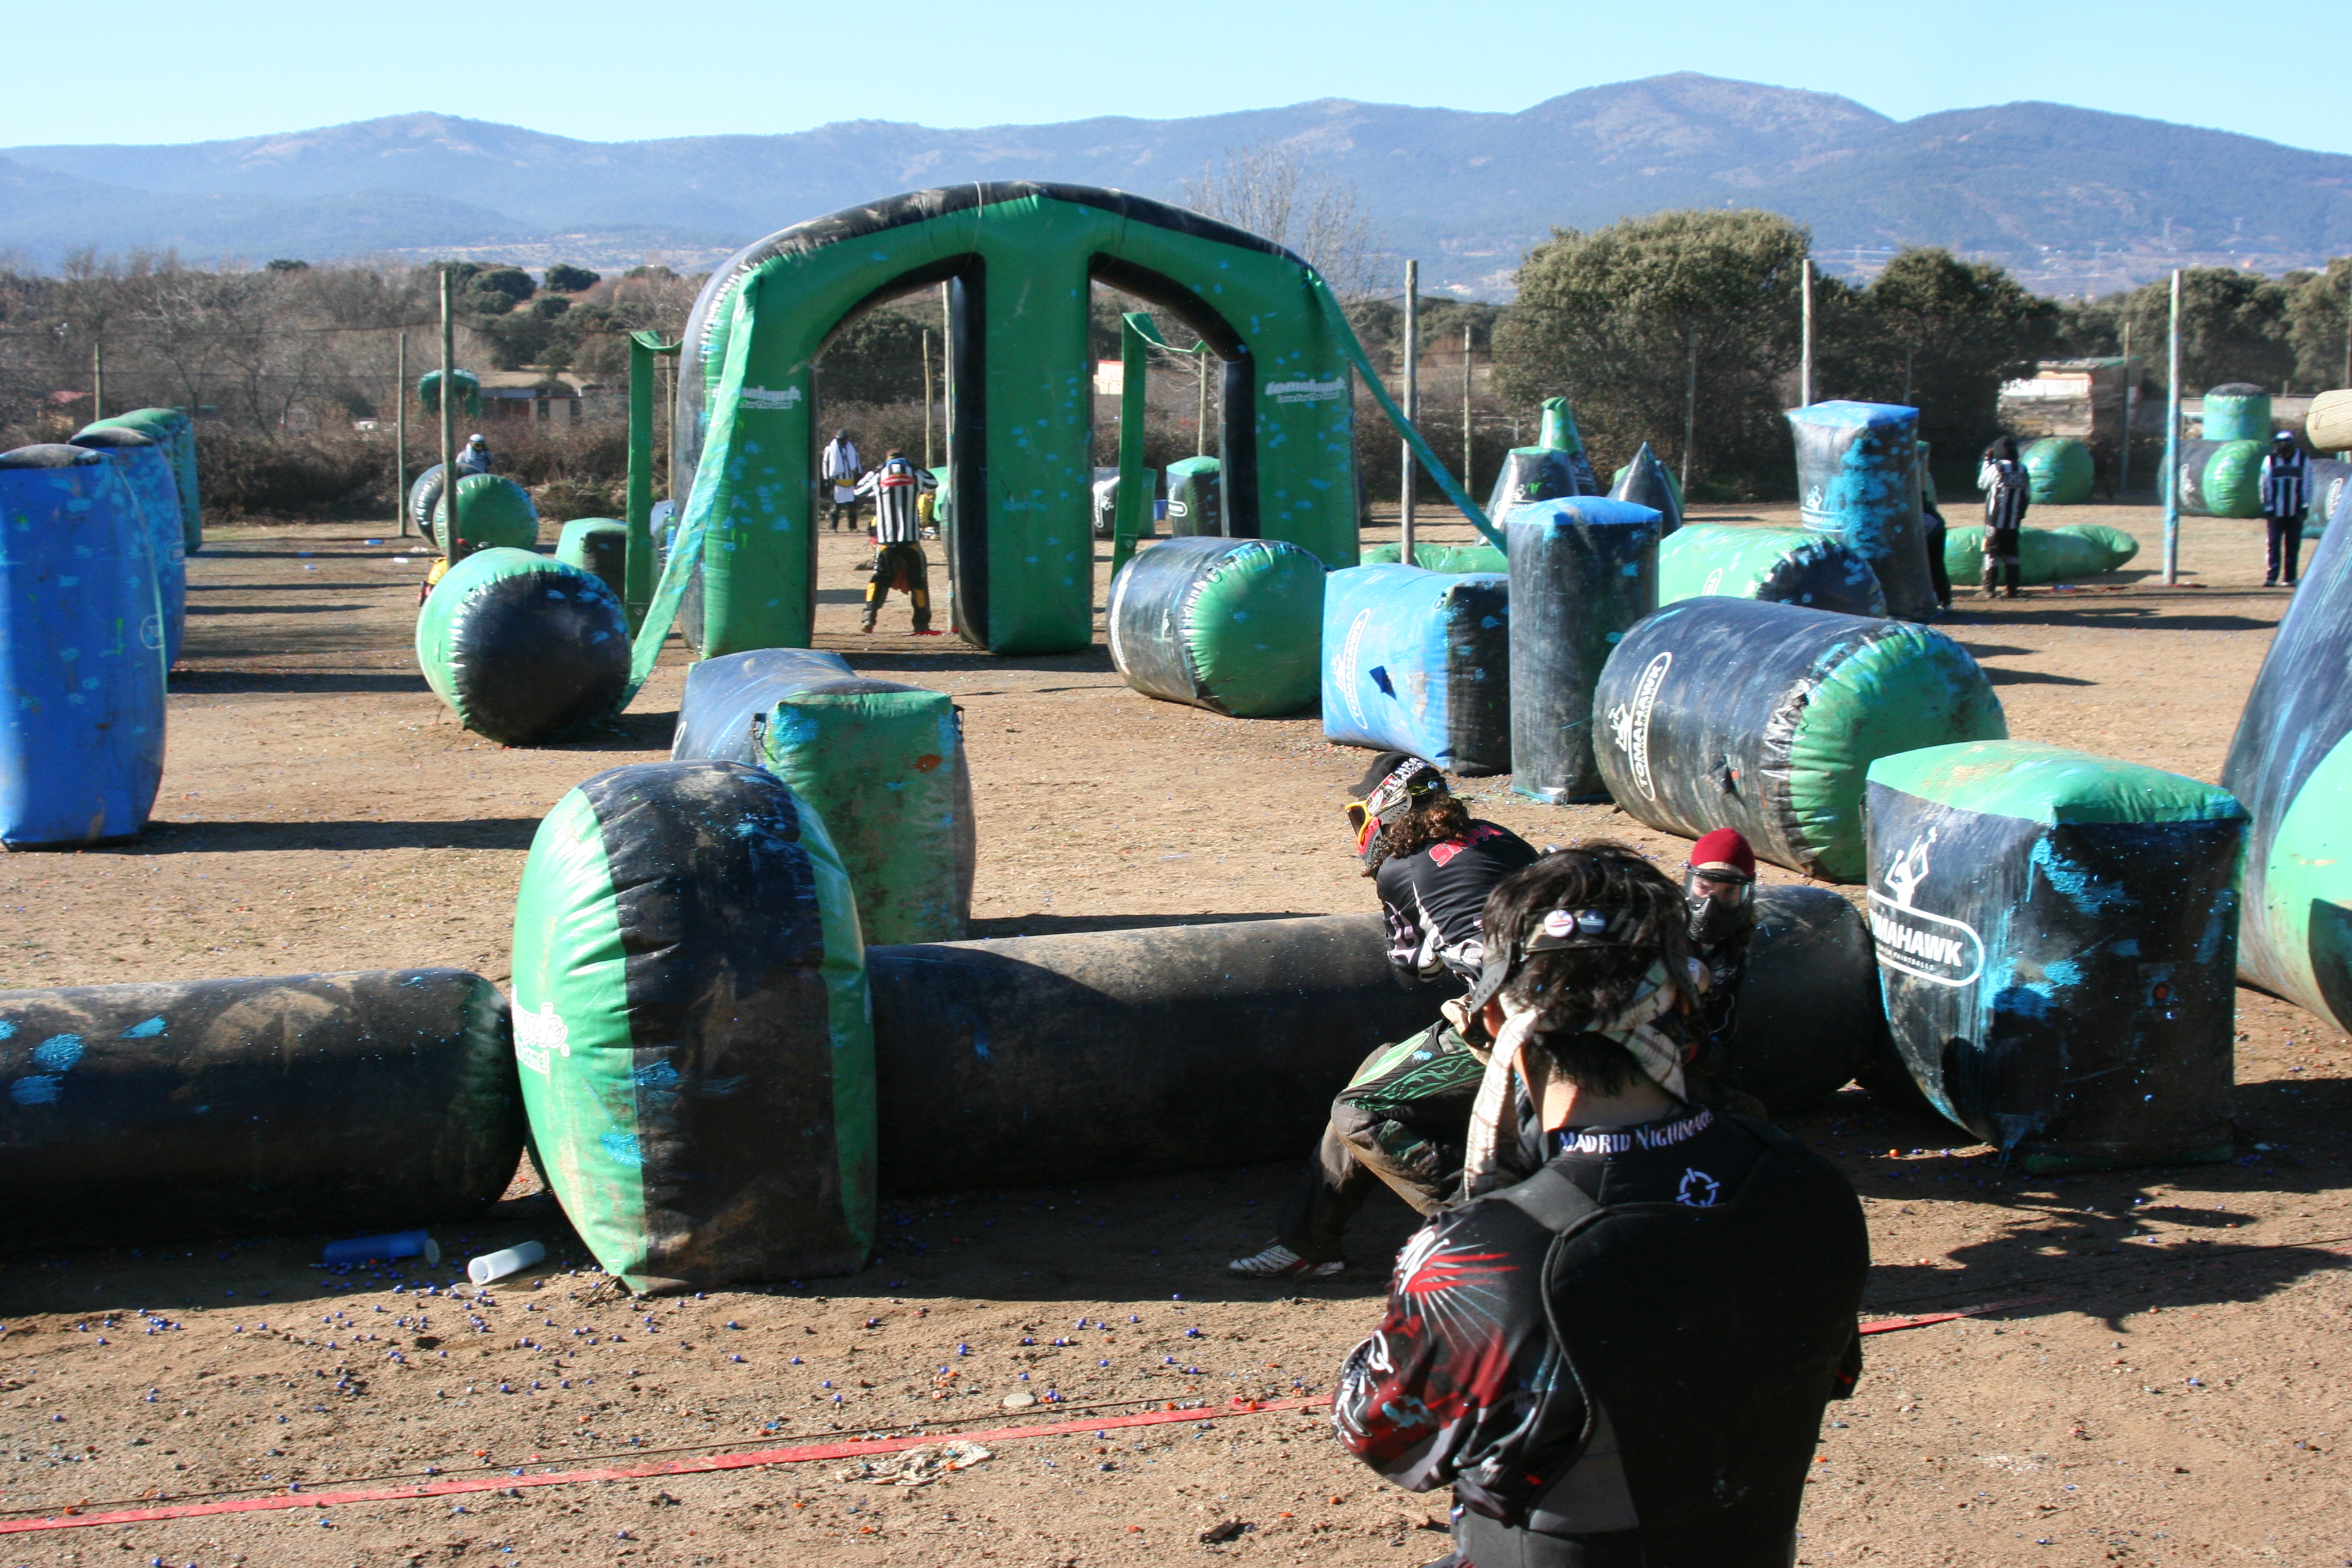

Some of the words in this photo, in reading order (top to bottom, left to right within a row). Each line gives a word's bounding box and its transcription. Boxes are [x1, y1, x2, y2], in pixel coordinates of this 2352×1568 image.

[1345, 620, 1365, 717] TOMAHAWK
[1633, 664, 1663, 787] TOMAHAWK
[1869, 909, 1964, 967] OMAHAWK
[1558, 1131, 1631, 1154] MADRID
